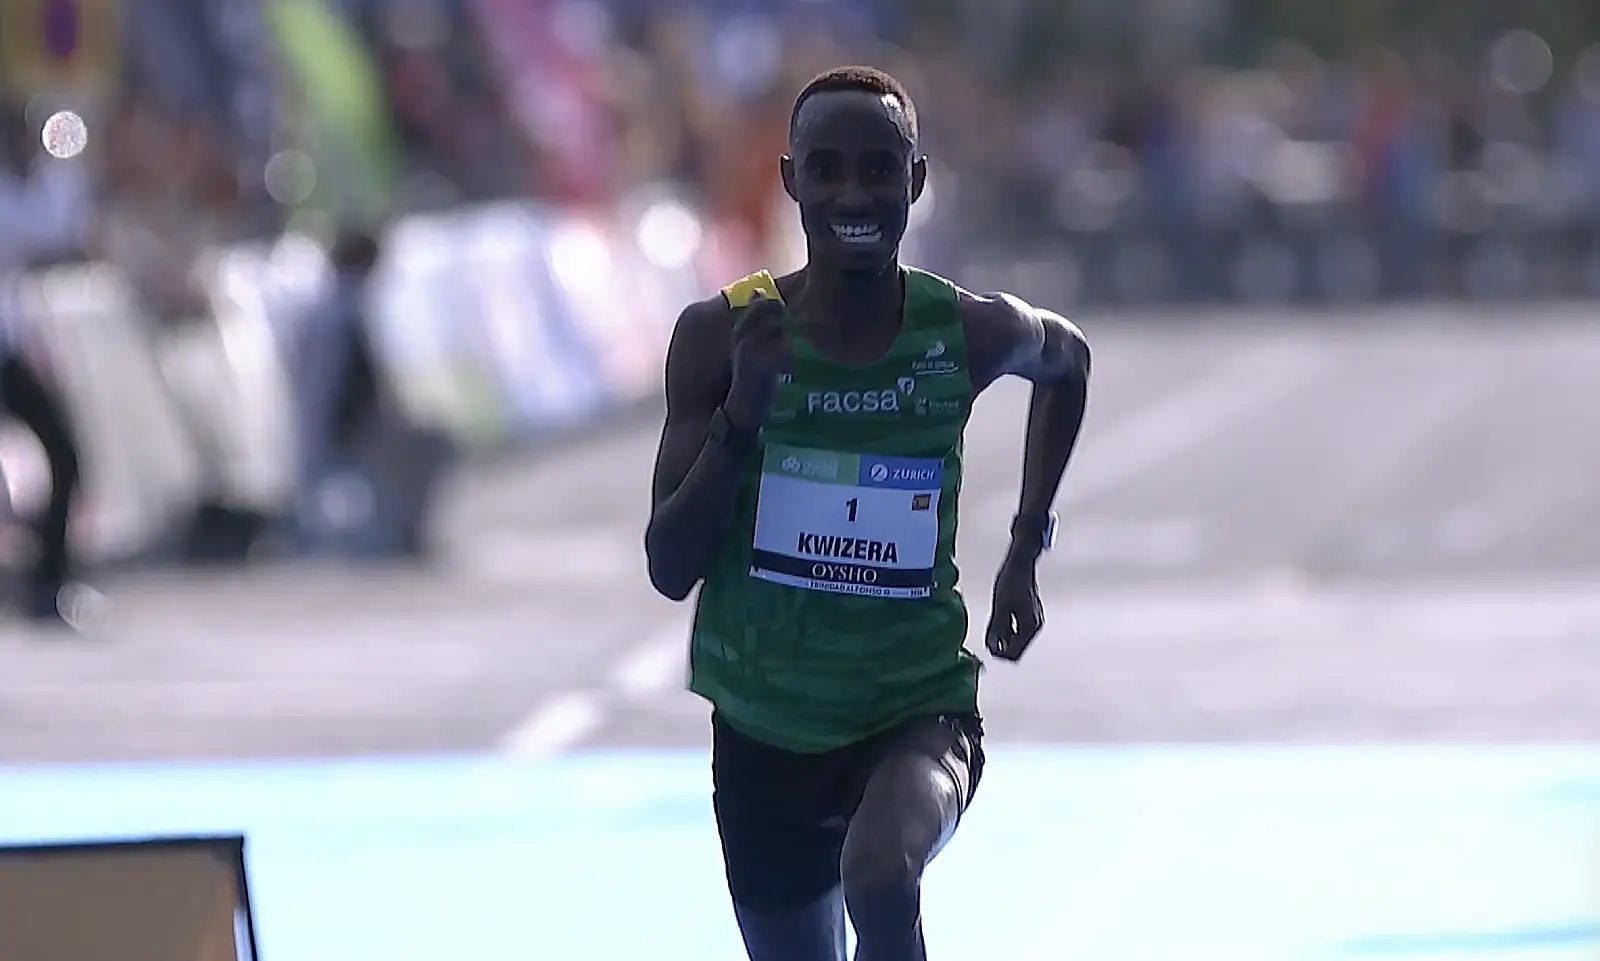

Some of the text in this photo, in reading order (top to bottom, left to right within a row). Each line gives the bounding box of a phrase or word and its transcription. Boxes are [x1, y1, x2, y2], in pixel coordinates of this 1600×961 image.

[892, 468, 935, 481] ZURICH
[845, 498, 858, 522] 1
[797, 531, 899, 564] KWIZERA
[812, 563, 877, 584] OYSHO
